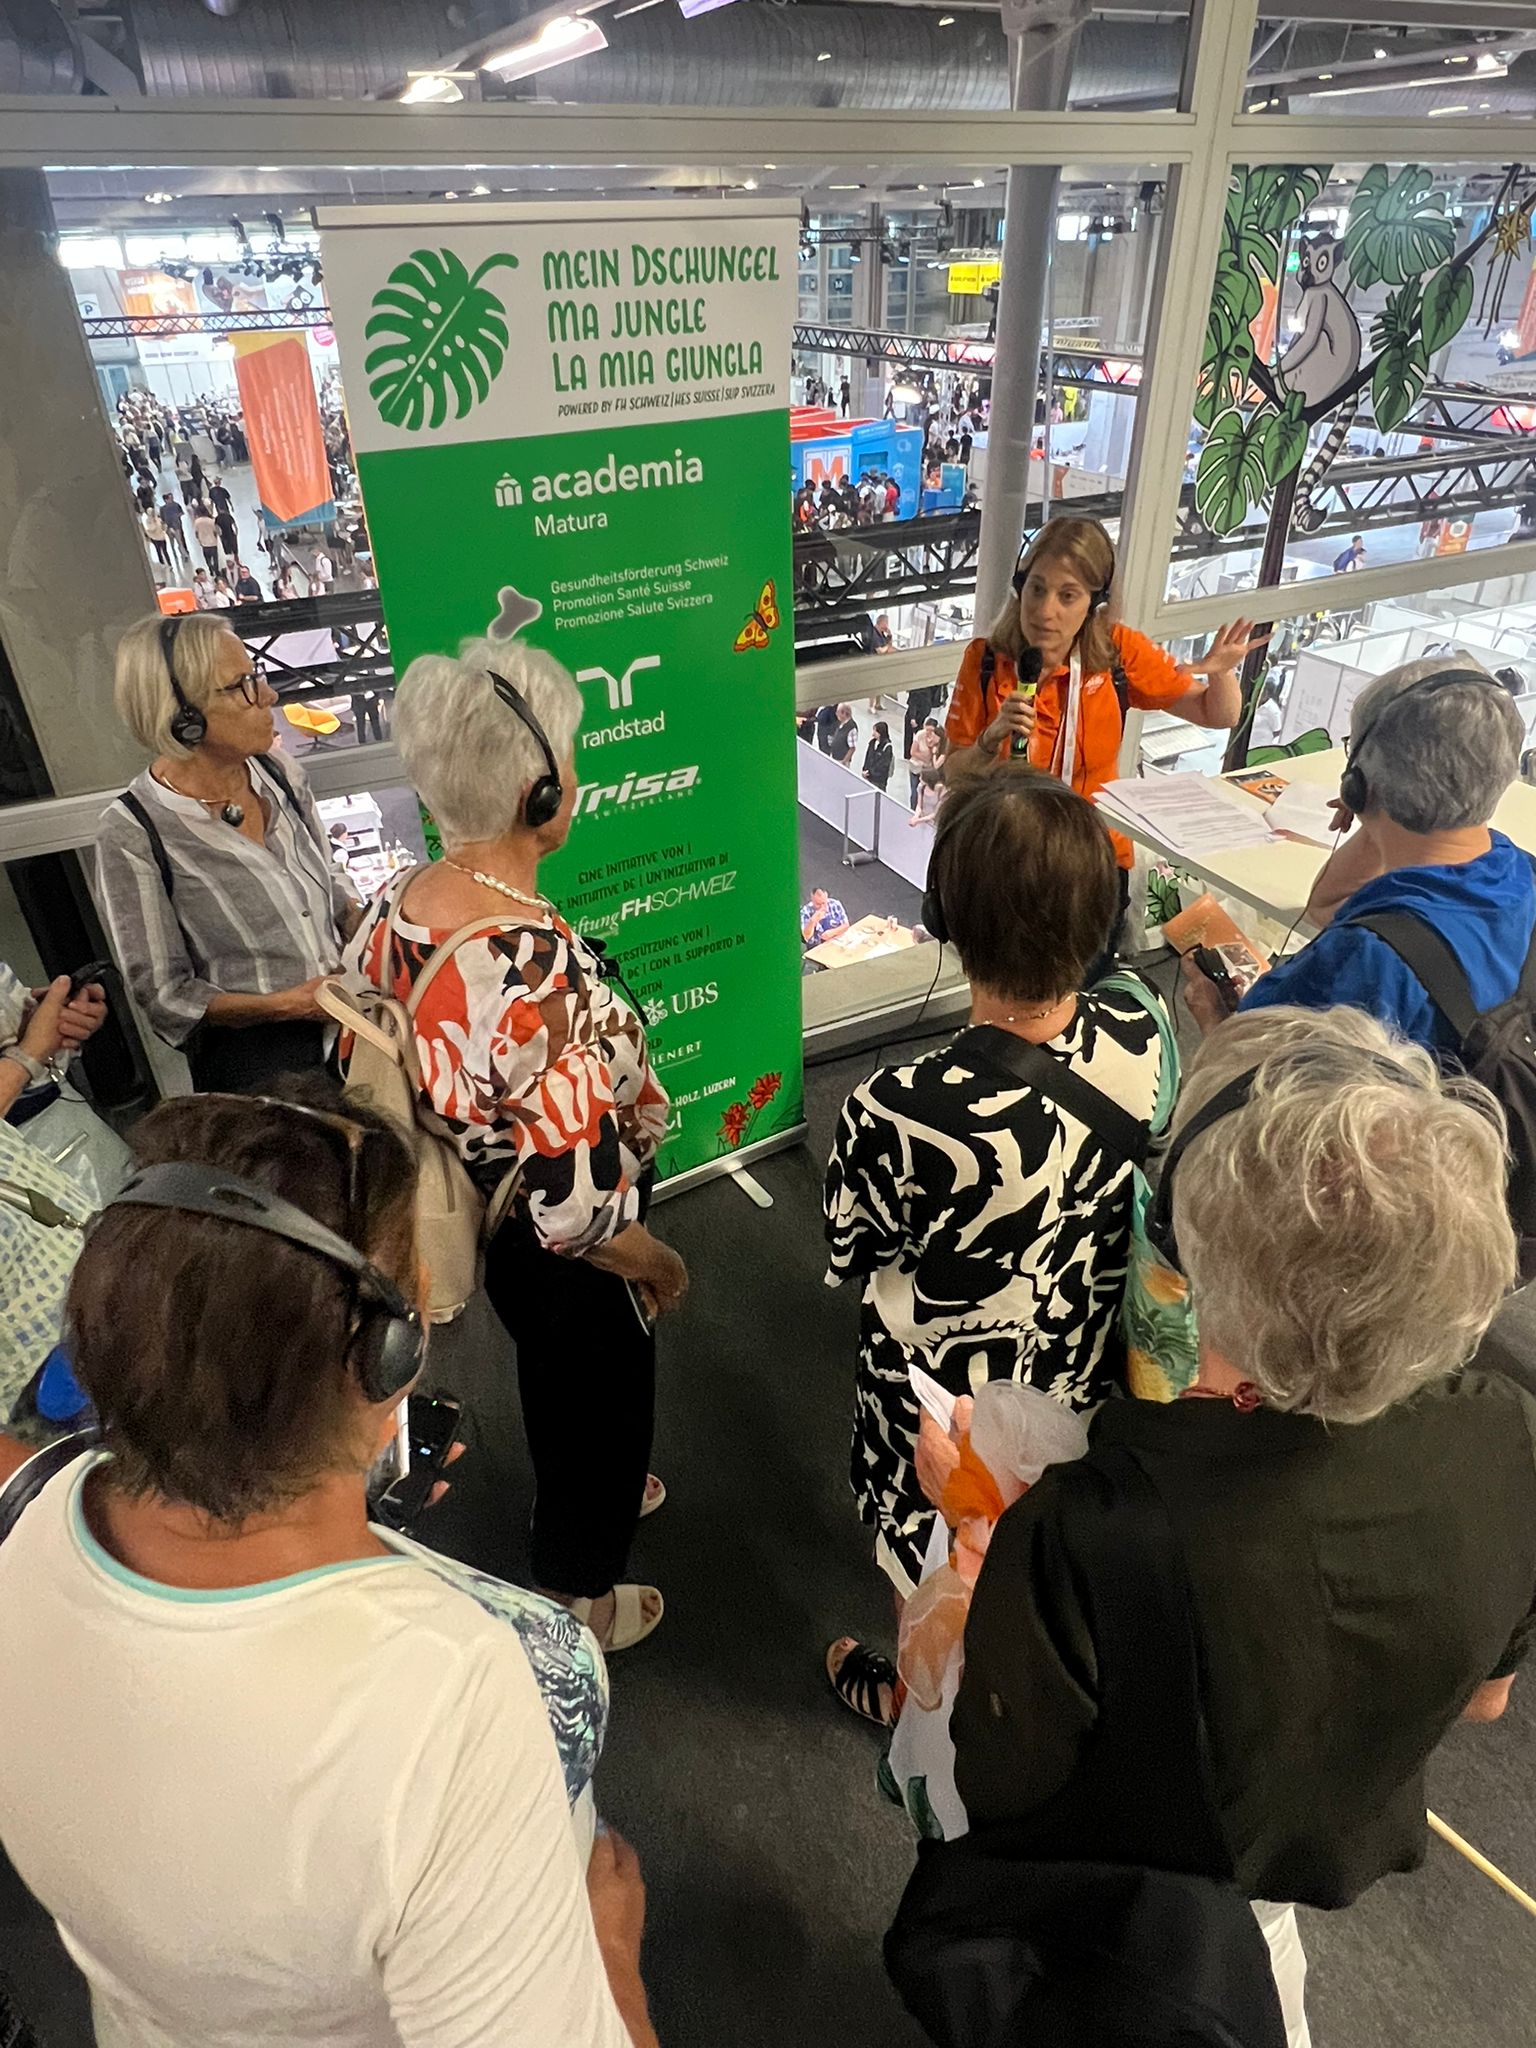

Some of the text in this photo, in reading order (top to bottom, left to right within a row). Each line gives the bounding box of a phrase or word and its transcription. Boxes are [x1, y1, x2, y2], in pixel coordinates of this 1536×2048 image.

[543, 244, 780, 290] MEIN DSCHUNGEL
[549, 298, 707, 342] MA JUNGLE
[553, 341, 763, 392] LA MIA GIUNGLA
[558, 404, 599, 417] POWERED
[601, 401, 613, 413] BY
[615, 399, 628, 411] FH
[741, 383, 776, 399] SVIZZERA
[531, 448, 704, 503] academia
[534, 511, 609, 537] Matura
[551, 554, 729, 594] Gesundheitsförderung Schweiz
[553, 579, 692, 612] Promotion Santé Suisse
[555, 592, 714, 631] Promozione Salute Svizzera
[581, 710, 666, 749] randstad
[567, 883, 620, 909] INITIATIVE
[623, 877, 636, 893] DE
[646, 857, 716, 885] UN'INIZIATIVA
[719, 852, 729, 865] DI
[578, 868, 604, 885] EINE
[606, 851, 658, 875] INITIATIVE
[661, 845, 686, 860] VON
[572, 870, 737, 936] iftung FHSCHWEIZ
[614, 935, 679, 963] TERSTÜTZUNG
[682, 927, 704, 943] VON
[627, 966, 640, 980] DE
[649, 956, 671, 971] CON
[674, 953, 682, 965] IL
[686, 936, 734, 961] SUPPORTO
[736, 934, 745, 946] DI
[670, 981, 720, 1014] UBS
[651, 1040, 702, 1066] IENERT
[703, 1076, 736, 1097] LUZERN
